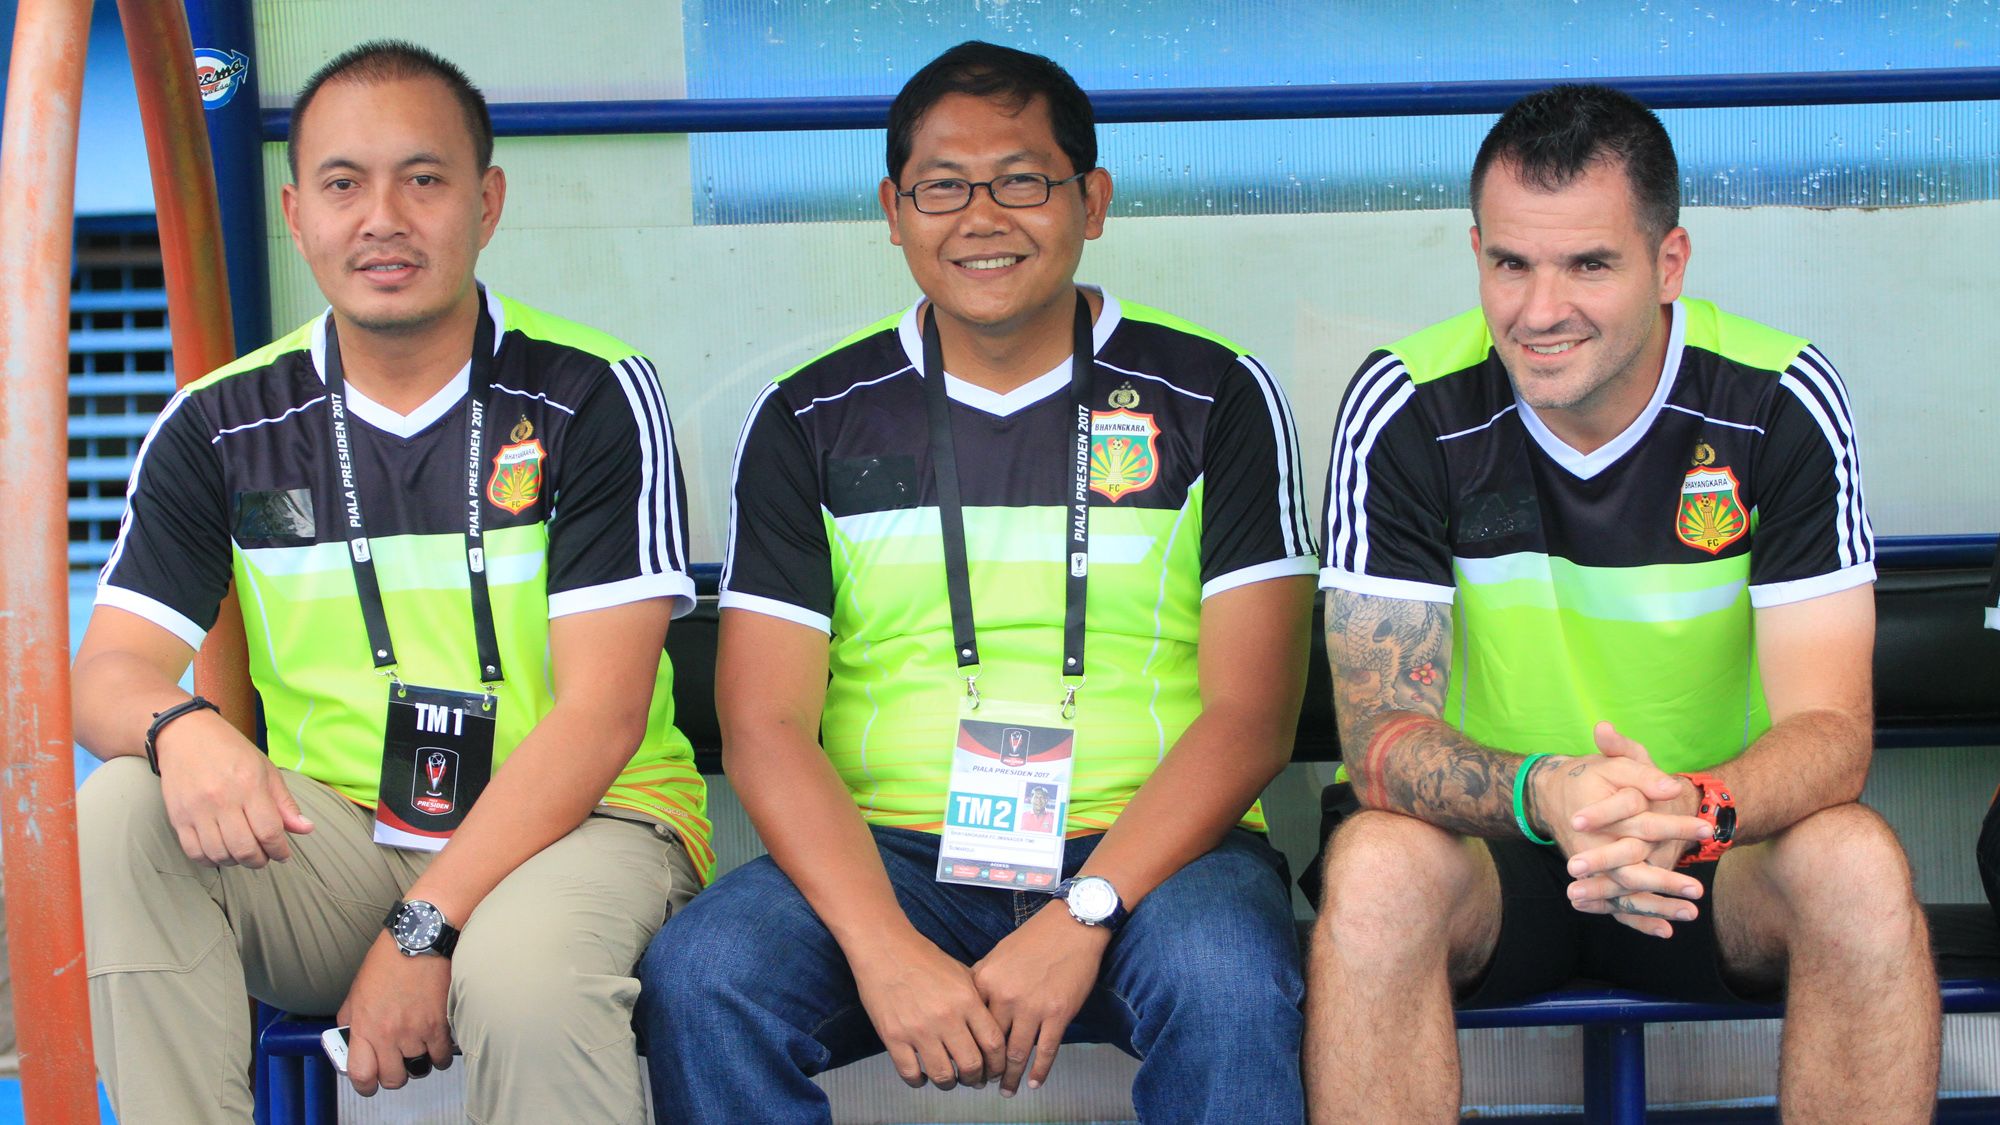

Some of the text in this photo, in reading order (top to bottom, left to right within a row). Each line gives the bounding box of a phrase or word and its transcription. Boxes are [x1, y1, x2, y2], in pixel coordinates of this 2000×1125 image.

[1095, 423, 1146, 433] BHAYANGKARA
[331, 393, 362, 528] PIALA PRESIDEN 2017
[469, 400, 484, 537] PIALA PRESIDEN 2017
[1074, 404, 1090, 542] PIALA PRESIDEN 2017
[1109, 483, 1120, 492] FC
[1685, 478, 1728, 489] BHAYANGKARA
[511, 500, 520, 508] FC
[1707, 538, 1720, 547] FC
[415, 702, 463, 736] TM 1
[972, 765, 1050, 779] PIALA PRESIDEN 2017
[417, 800, 450, 809] PRESIDEN
[956, 795, 1012, 828] TM 2
